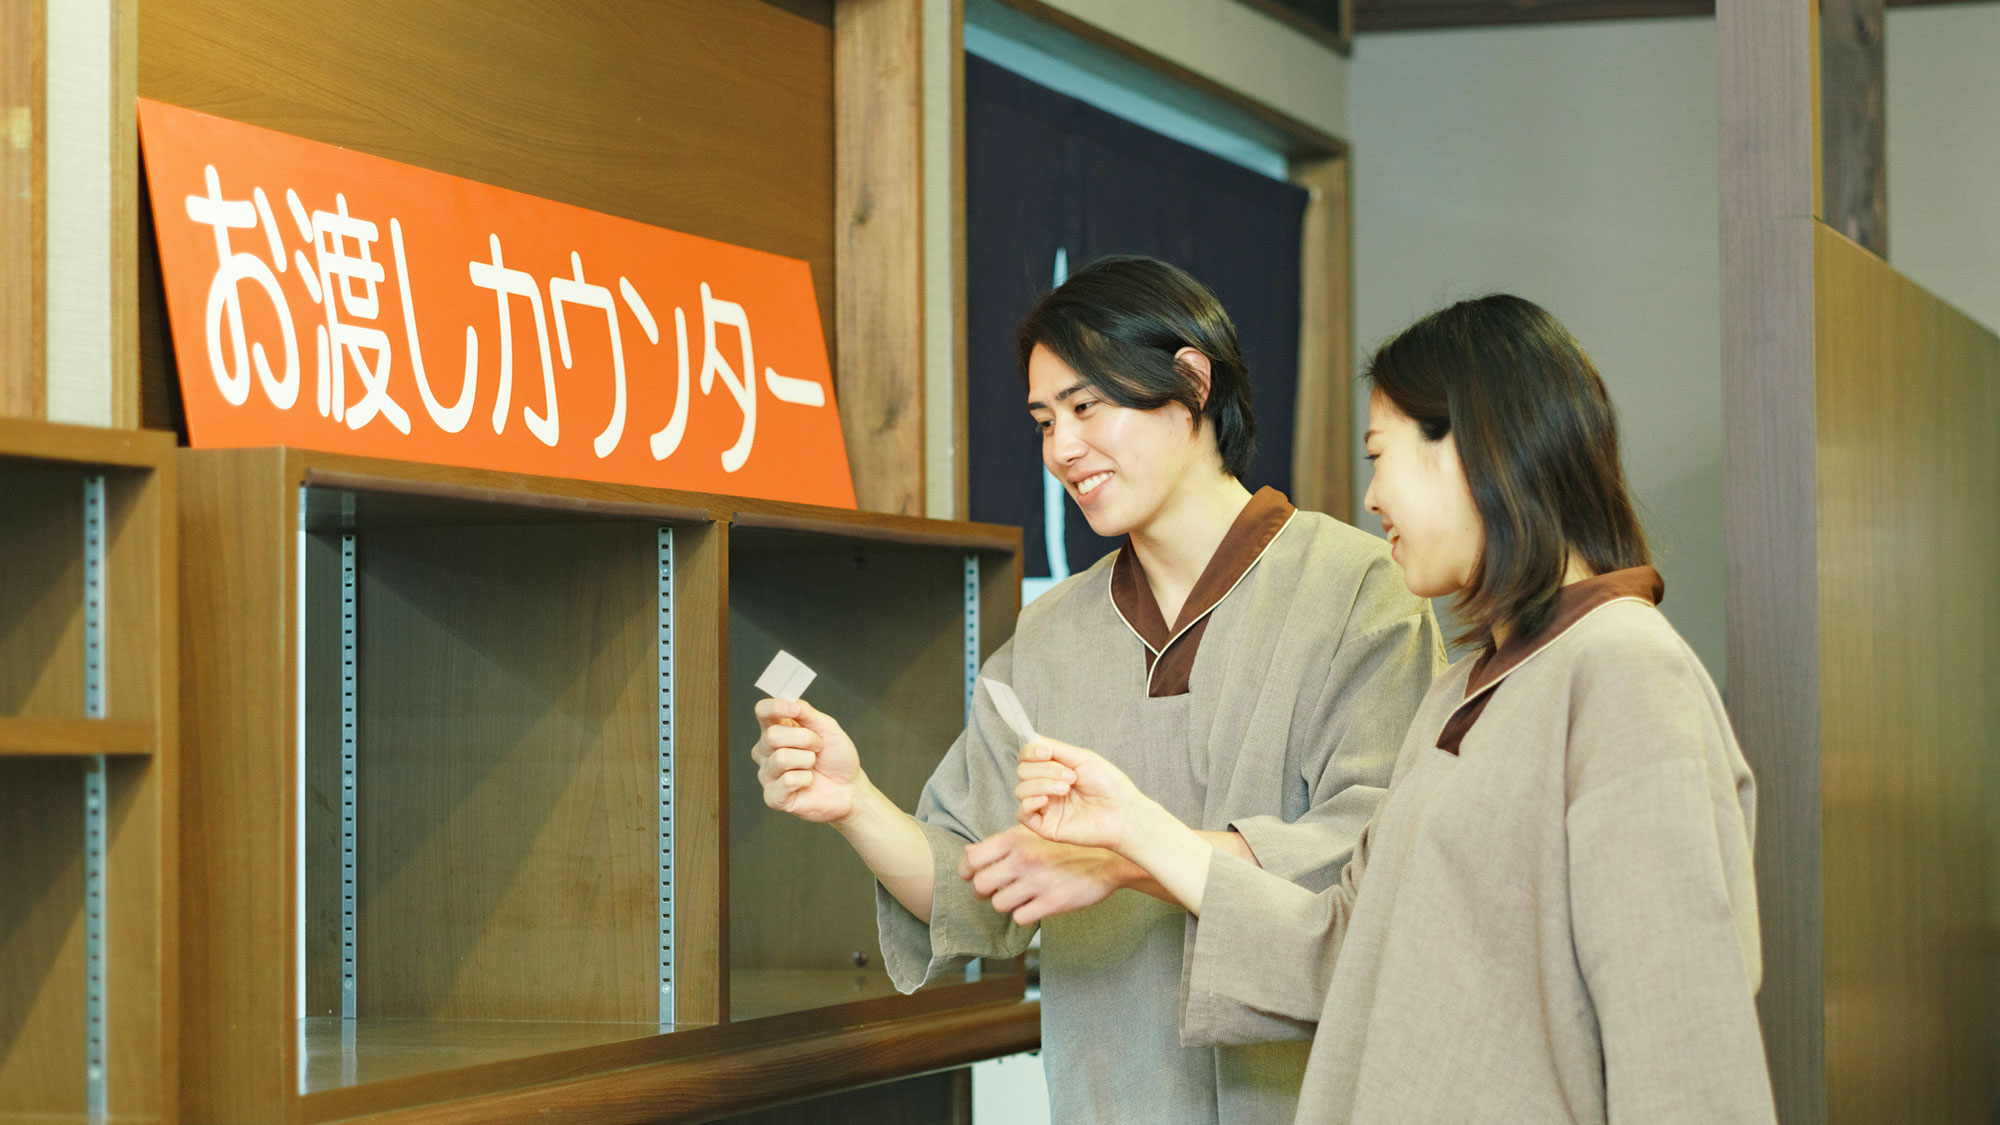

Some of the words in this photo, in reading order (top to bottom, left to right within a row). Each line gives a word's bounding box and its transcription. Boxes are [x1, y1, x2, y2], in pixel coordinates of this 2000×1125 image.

[185, 164, 825, 473] お渡しカウンター
